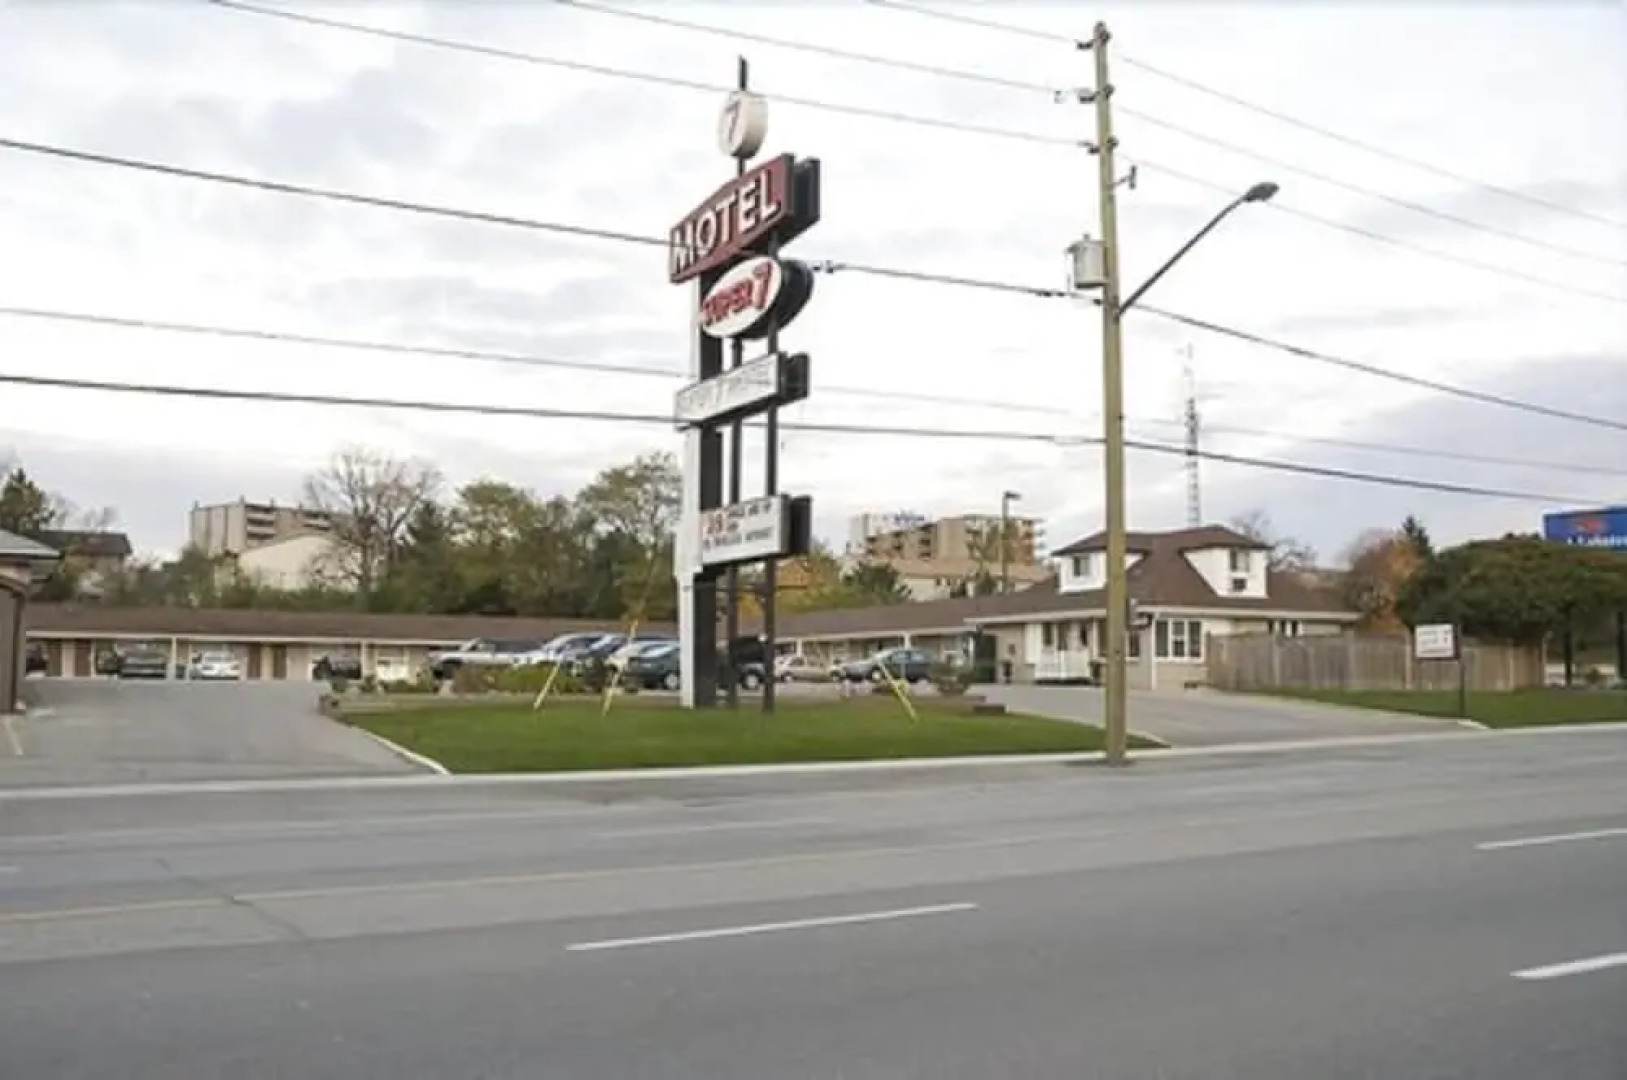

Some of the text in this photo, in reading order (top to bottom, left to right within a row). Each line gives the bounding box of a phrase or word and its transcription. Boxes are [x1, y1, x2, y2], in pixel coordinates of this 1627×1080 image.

[725, 100, 741, 142] 7
[672, 169, 781, 275] MOTEL
[699, 261, 773, 327] UPER 7
